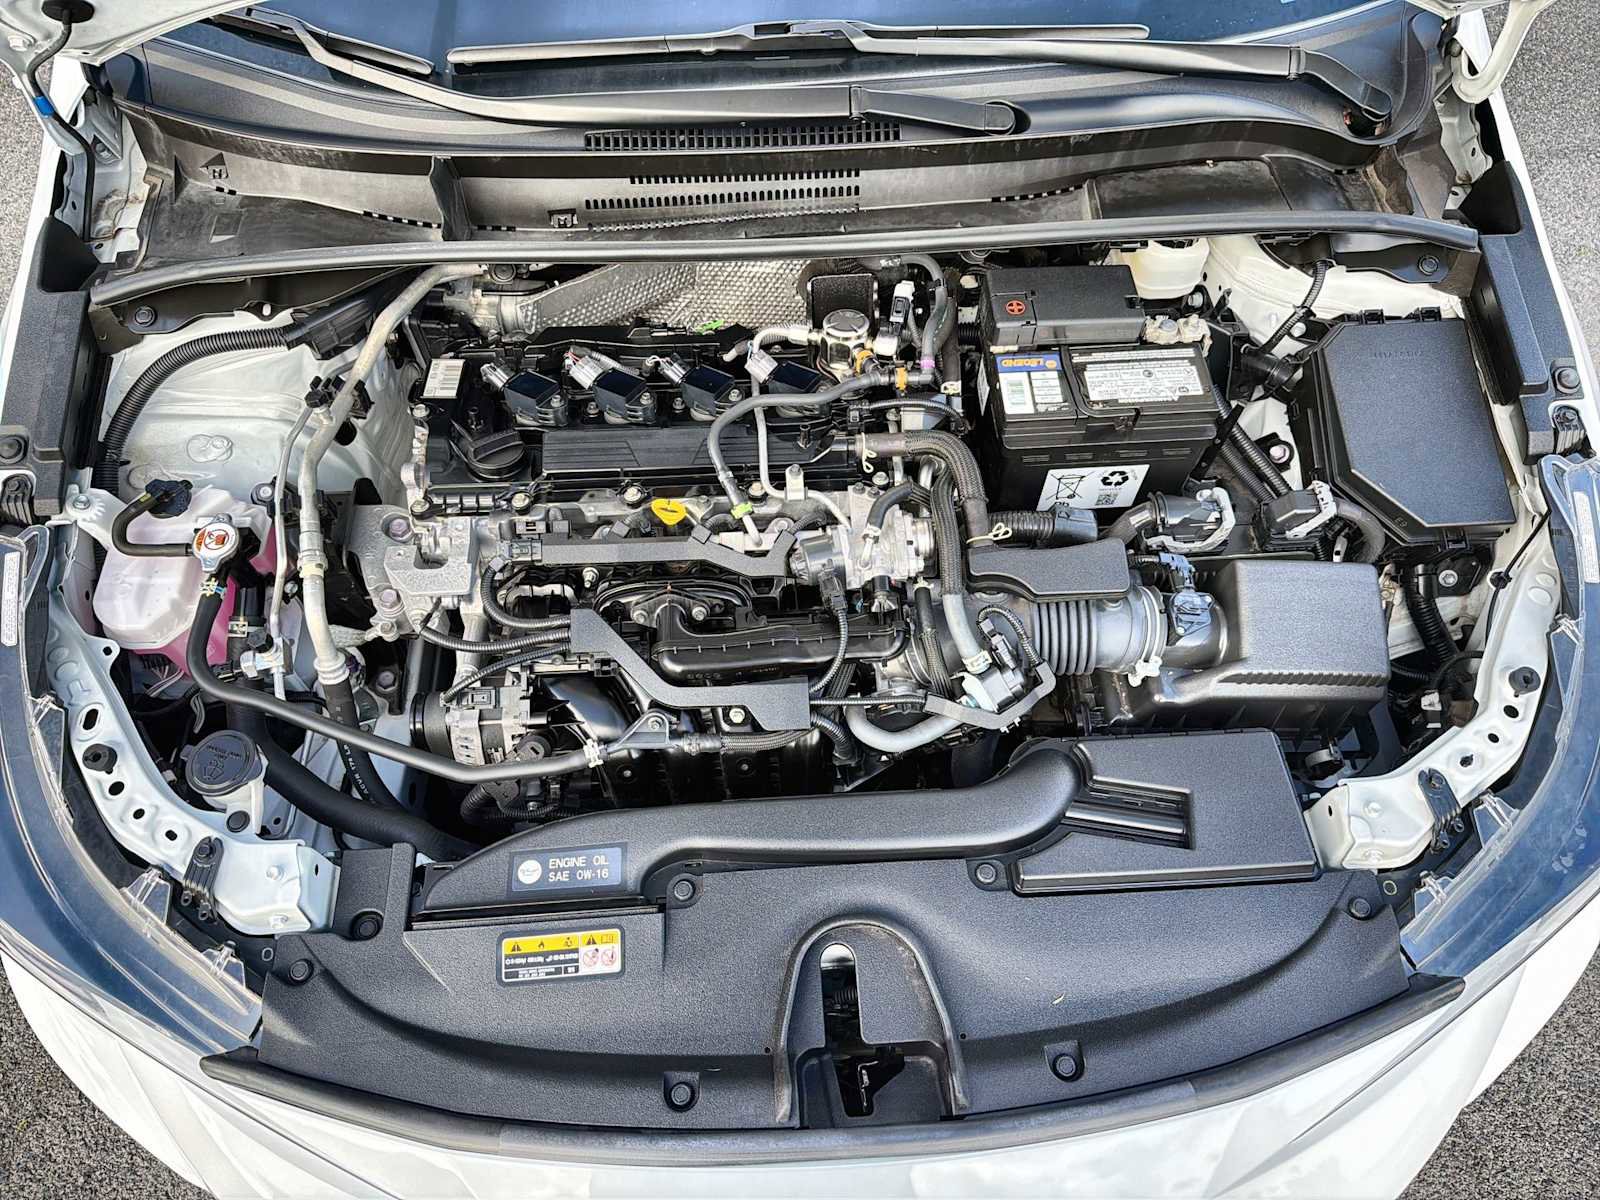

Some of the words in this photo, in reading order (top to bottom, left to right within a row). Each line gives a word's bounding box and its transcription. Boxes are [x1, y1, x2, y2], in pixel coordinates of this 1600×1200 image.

[548, 856, 587, 869] ENGINE
[592, 855, 609, 866] OIL
[548, 870, 570, 882] SAE
[576, 868, 609, 880] 0W-16
